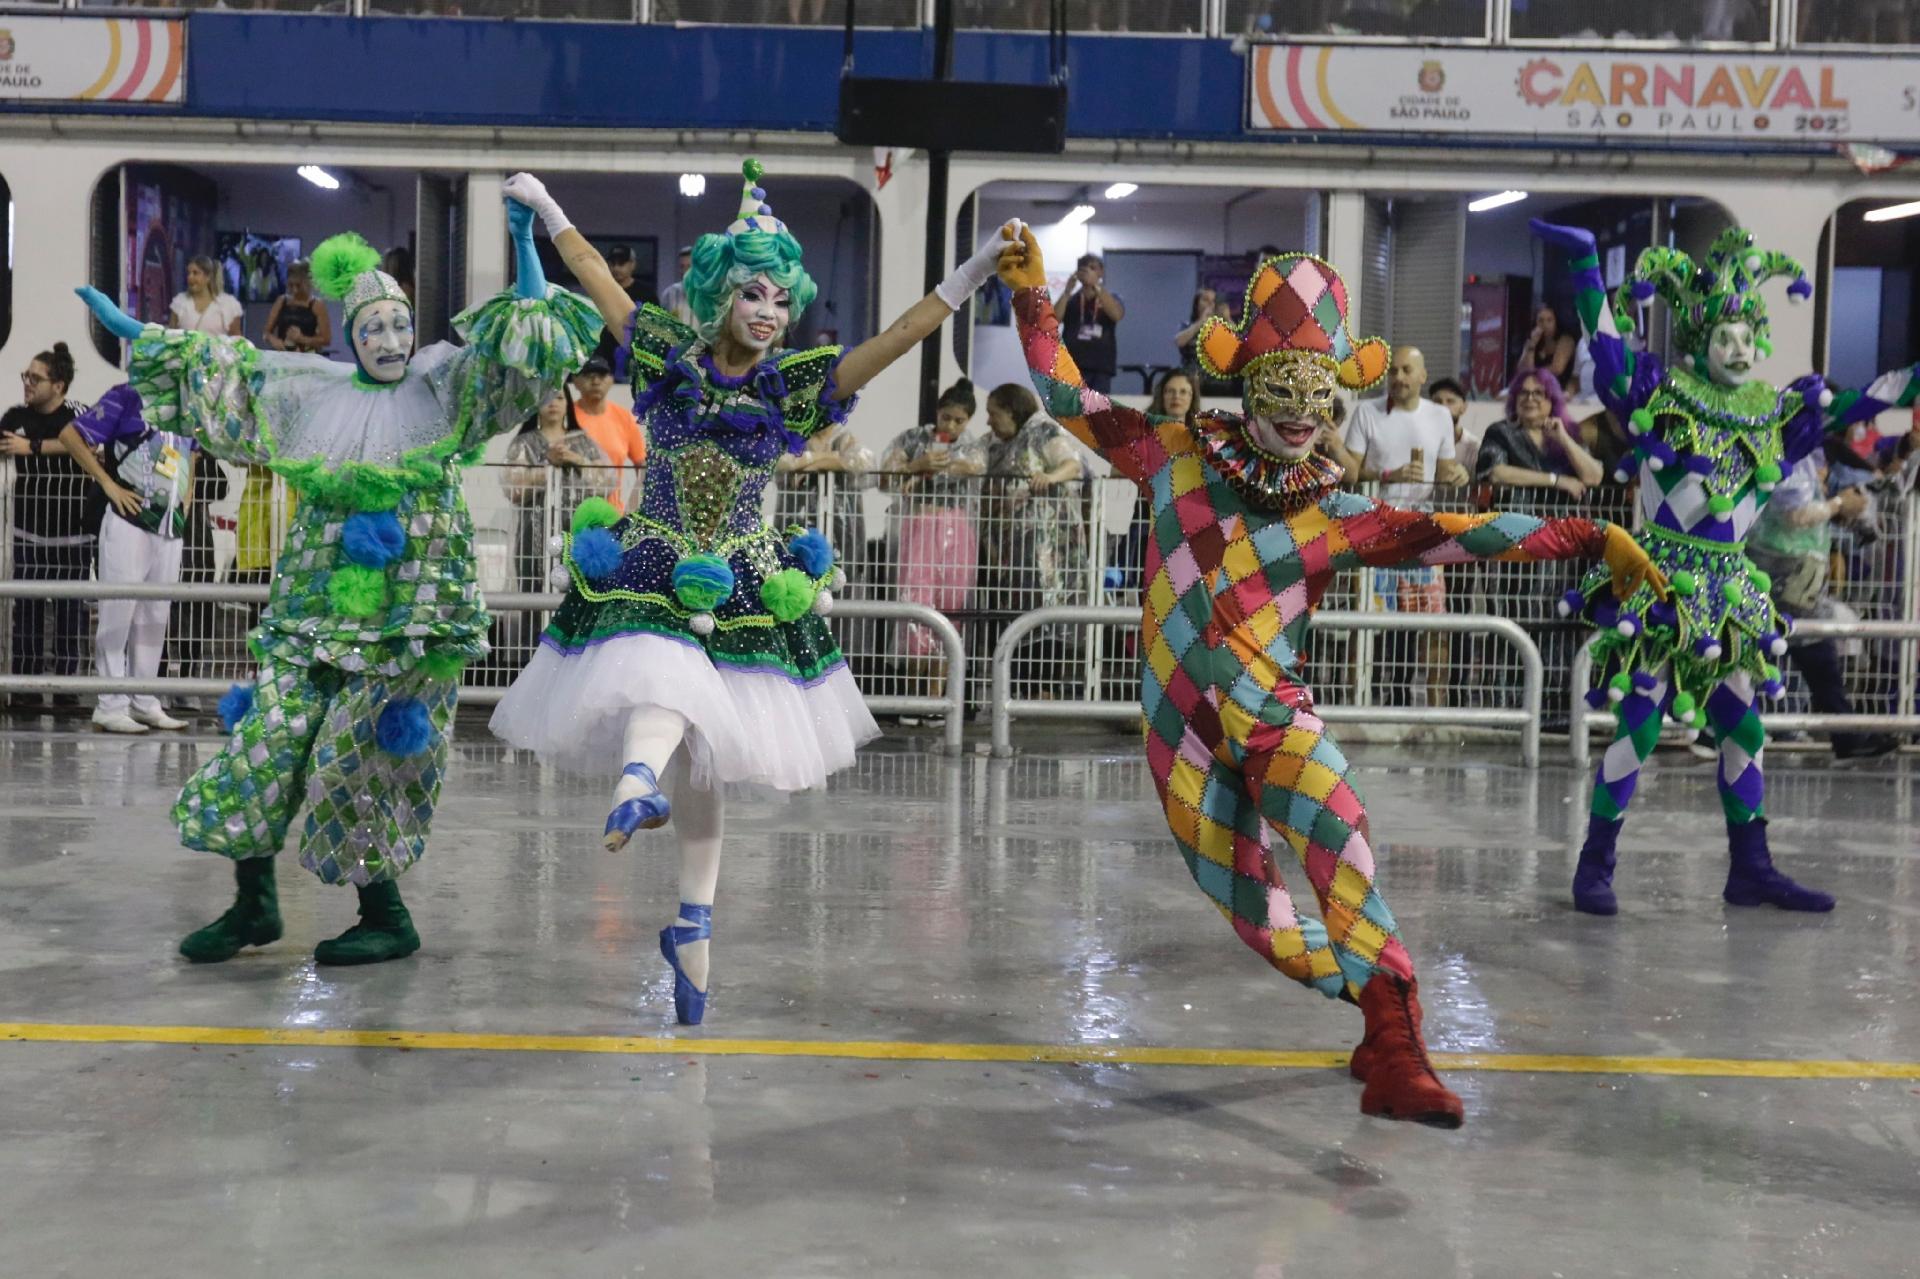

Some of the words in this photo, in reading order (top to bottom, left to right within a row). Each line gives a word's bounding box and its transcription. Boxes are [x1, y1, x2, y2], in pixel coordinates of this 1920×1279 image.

[15, 64, 31, 74] DE
[1515, 56, 1848, 109] CARNAVAL
[1423, 108, 1471, 120] PAULO
[1658, 112, 1769, 131] PAULO
